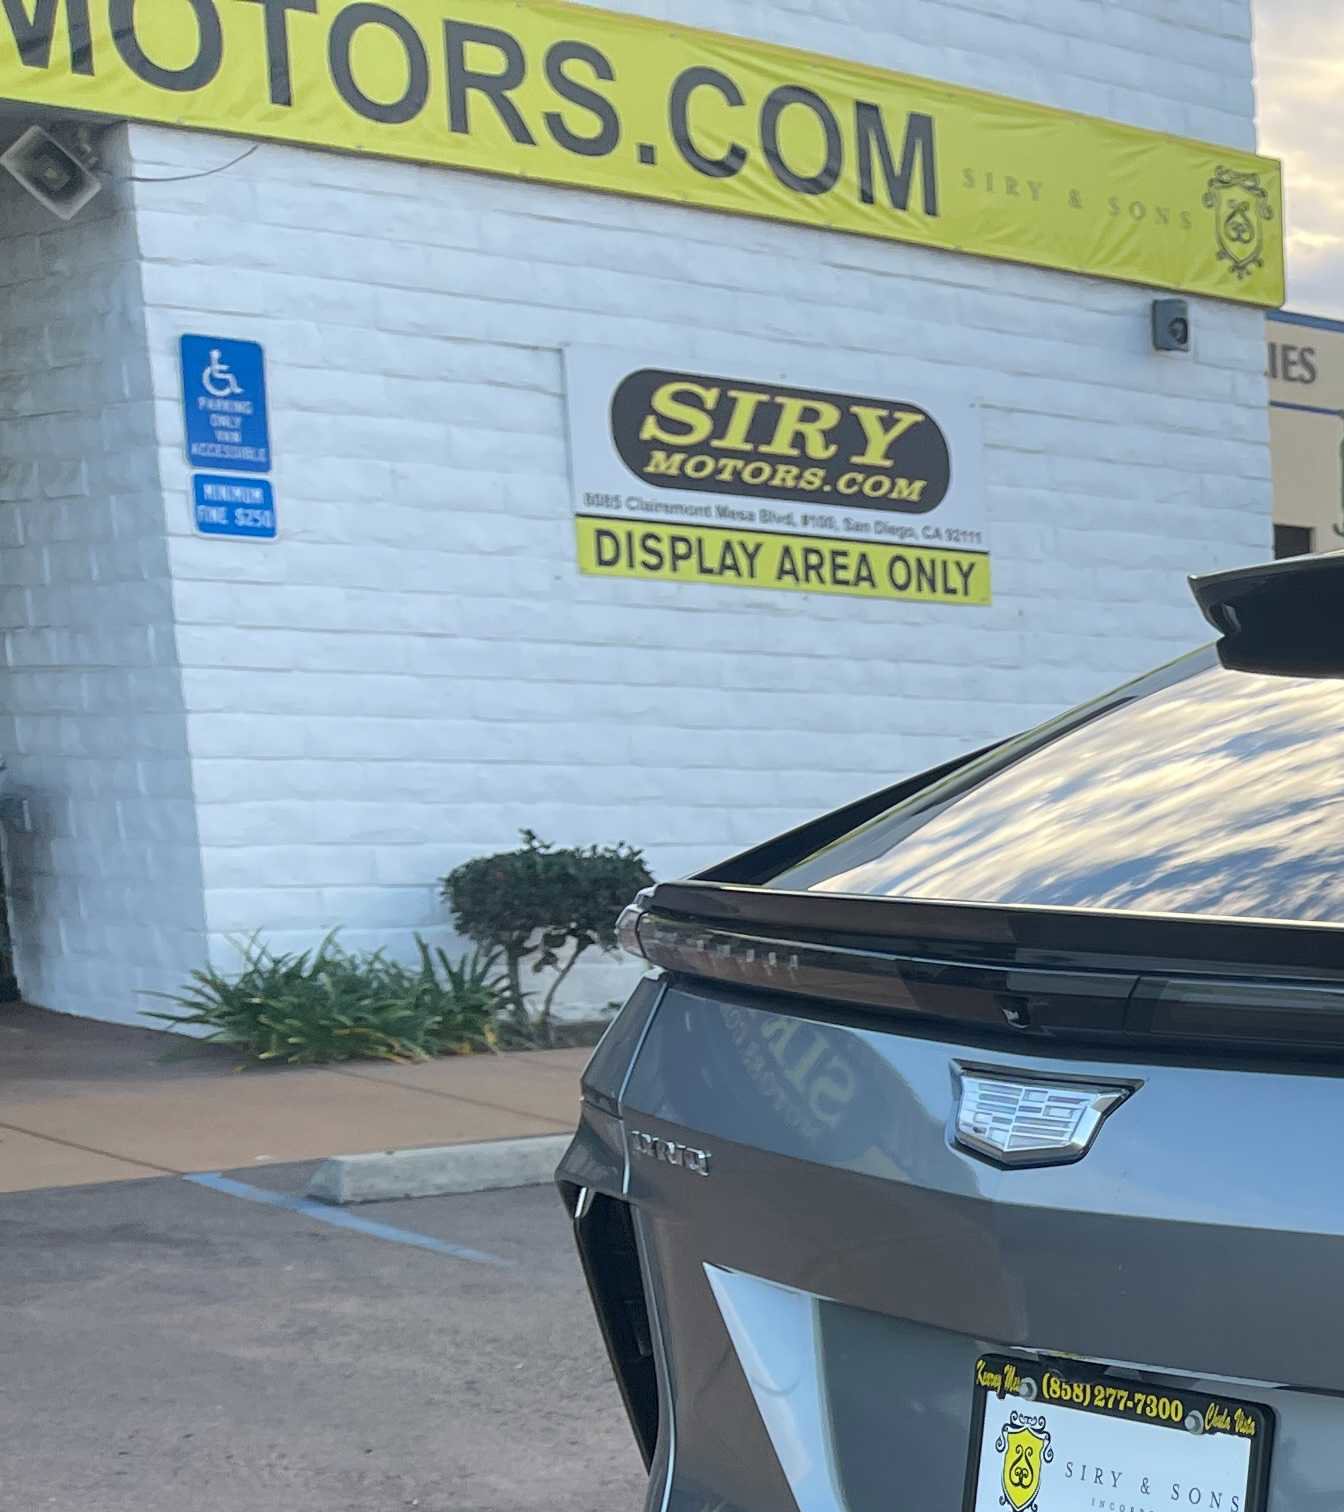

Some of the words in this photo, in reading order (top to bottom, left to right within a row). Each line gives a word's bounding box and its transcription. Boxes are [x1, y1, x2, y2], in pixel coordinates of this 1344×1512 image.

[0, 0, 940, 218] MOTORS.COM
[962, 167, 1043, 201] SIRY
[1068, 189, 1082, 208] &
[1108, 196, 1192, 230] SONS
[1264, 342, 1316, 384] IES
[639, 381, 925, 468] SIRY
[644, 450, 928, 502] MOTORS.COM
[921, 525, 943, 540] CA
[594, 528, 763, 580] DISPLAY
[776, 545, 877, 588] AREA
[888, 554, 976, 597] ONLY
[1093, 1385, 1184, 1423] 277-7300
[1065, 1461, 1122, 1488] SIRY
[1140, 1477, 1151, 1495] &
